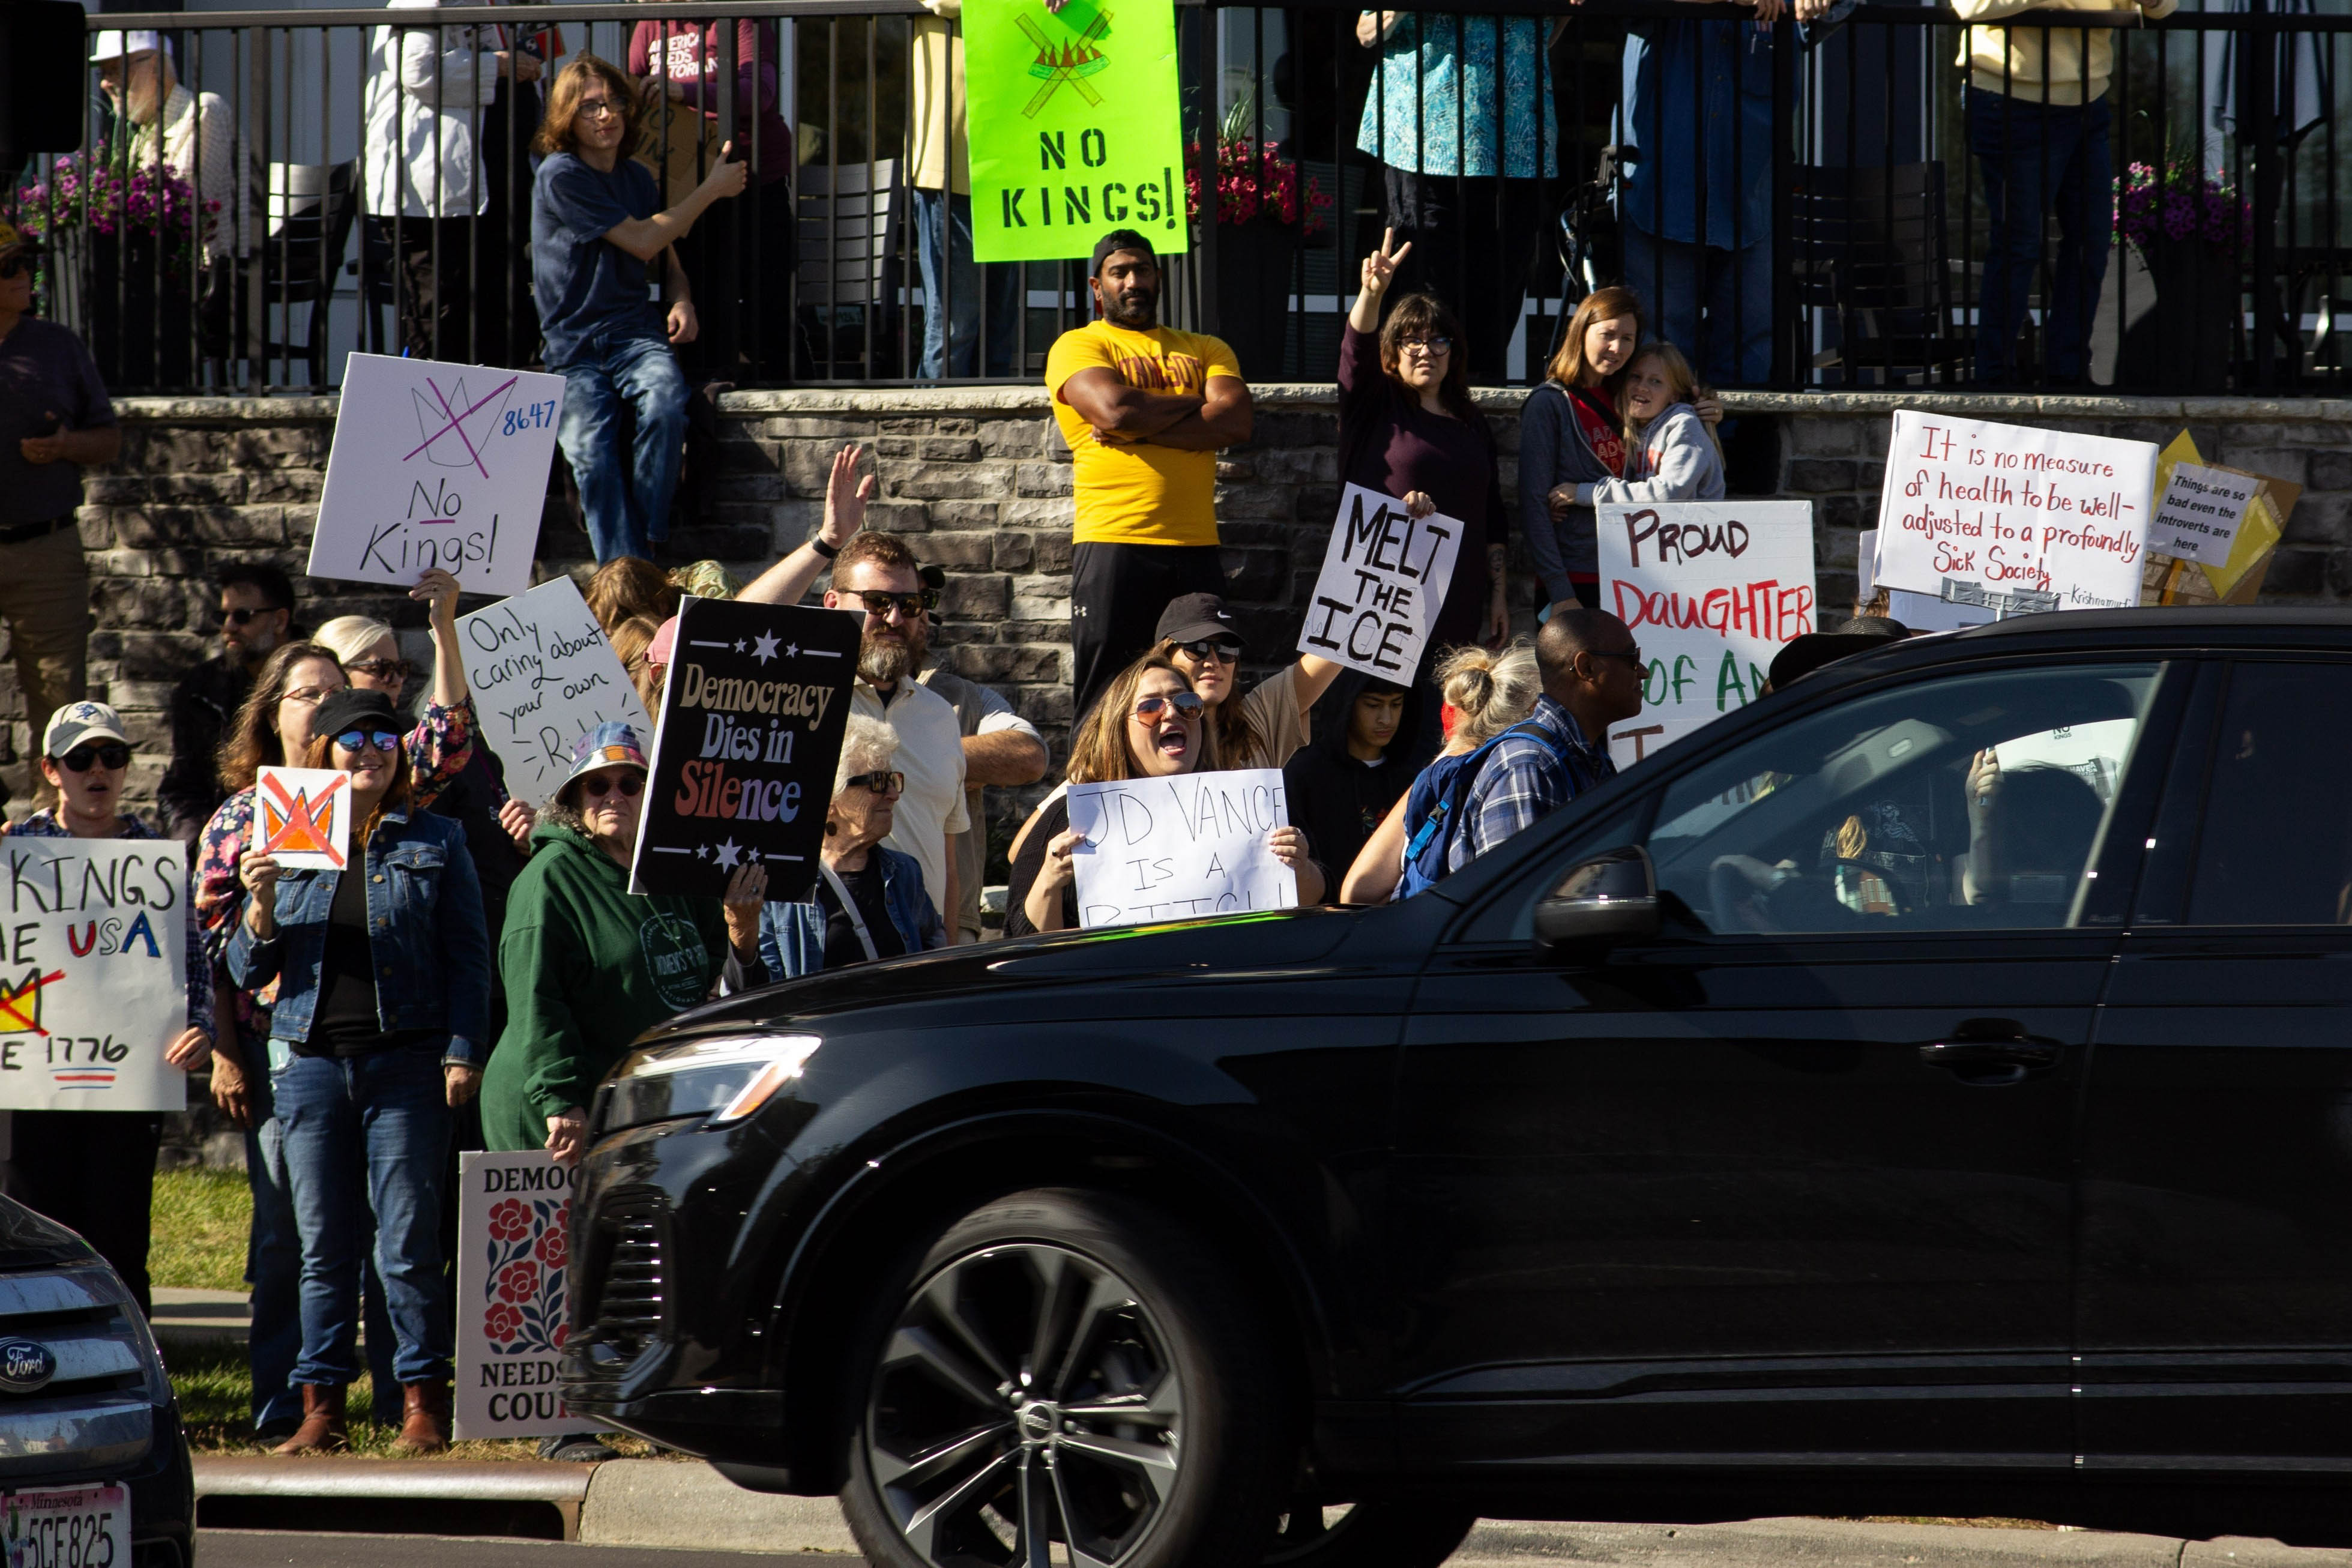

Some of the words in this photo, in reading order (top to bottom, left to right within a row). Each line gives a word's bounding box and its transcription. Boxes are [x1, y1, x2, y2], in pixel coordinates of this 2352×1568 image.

[1040, 128, 1106, 170] NO
[1002, 167, 1176, 230] KINGS!
[502, 400, 556, 436] 8647
[1919, 426, 1957, 462] It
[1968, 433, 1986, 466] is
[1994, 451, 2018, 469] no
[407, 478, 462, 519] No
[1905, 469, 1929, 497] of
[1938, 471, 2013, 505] health
[2021, 480, 2042, 507] to
[2046, 482, 2073, 511] be
[2079, 492, 2135, 520] well-
[2166, 494, 2190, 509] bad
[2190, 501, 2216, 514] even
[2218, 507, 2236, 519] the
[2174, 475, 2209, 495] Things
[2211, 485, 2231, 498] are
[2233, 491, 2246, 501] so
[360, 514, 499, 575] Kings!
[1342, 493, 1450, 585] MELT
[1902, 503, 1983, 540] adjusted
[1989, 512, 2015, 540] to
[2021, 526, 2033, 542] a
[2042, 524, 2141, 563] profoundly
[2156, 512, 2210, 534] introverts
[2212, 526, 2231, 538] are
[2173, 537, 2198, 552] here
[1934, 541, 1976, 573] Sick
[1985, 545, 2052, 592] Society
[1354, 568, 1413, 620] THE
[469, 606, 543, 653] Only
[1307, 596, 1414, 671] ICE
[473, 654, 564, 690] caring
[550, 623, 603, 660] about
[1643, 654, 1699, 707] OF
[498, 692, 543, 734] your
[562, 672, 610, 700] own
[679, 663, 835, 732] Democracy
[699, 713, 761, 761] Dies
[764, 719, 794, 764] in
[674, 759, 801, 824] Silence
[1076, 787, 1153, 849] JD
[1168, 776, 1283, 842] VANCE
[10, 849, 177, 913] KINGS
[1126, 857, 1174, 891] IS
[1205, 851, 1226, 879] A
[67, 909, 161, 959] USA
[46, 1034, 130, 1064] 1776
[7, 1346, 47, 1377] Ford
[31, 1492, 83, 1510] Minnesota
